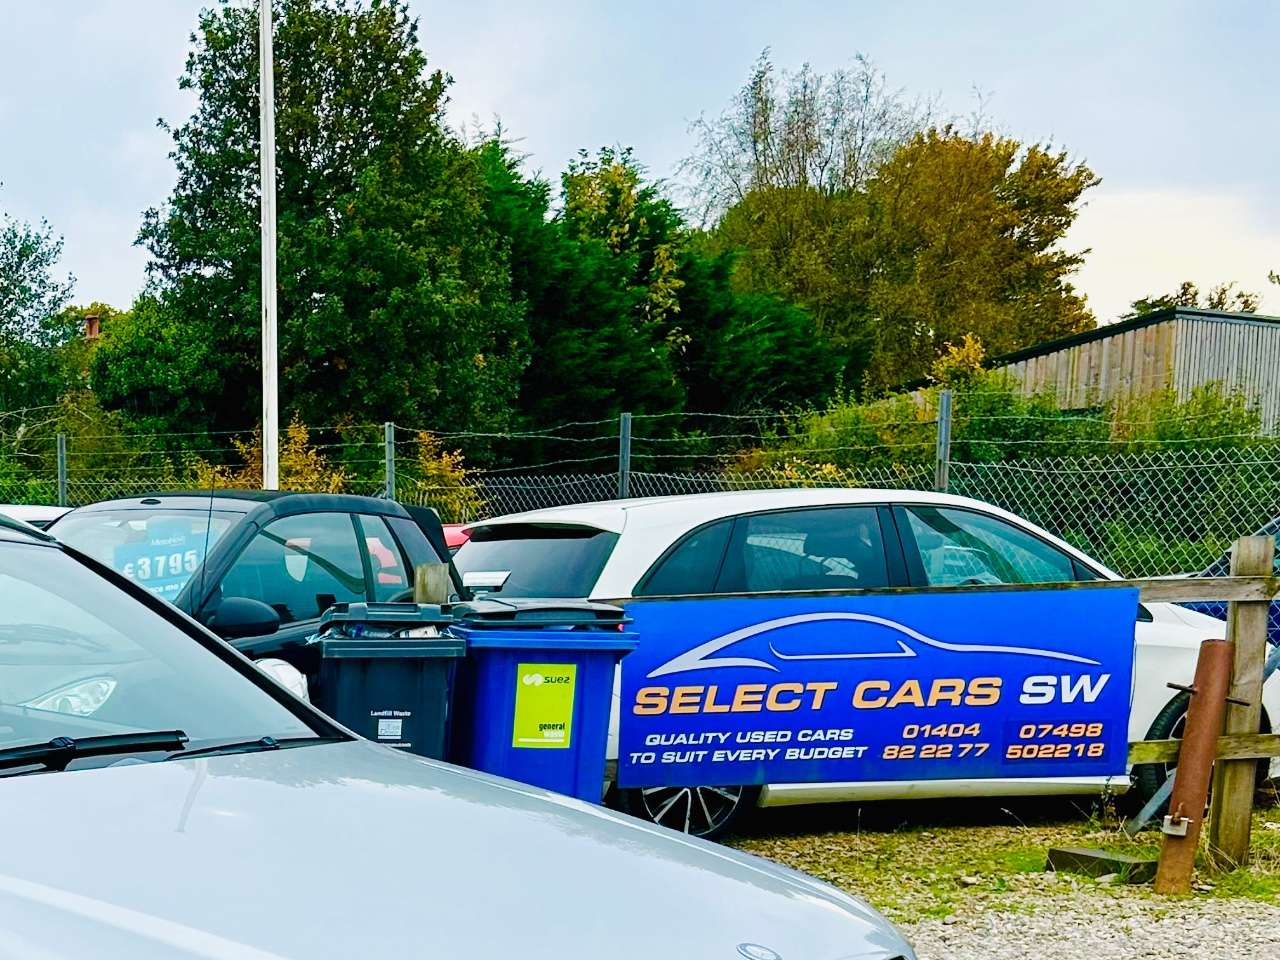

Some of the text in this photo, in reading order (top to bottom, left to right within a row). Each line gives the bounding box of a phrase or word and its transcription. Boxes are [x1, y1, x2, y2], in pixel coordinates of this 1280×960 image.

[543, 676, 570, 684] suez
[632, 673, 1112, 716] SELECT CARS SW
[538, 722, 566, 732] general
[902, 723, 981, 739] 01404
[1019, 723, 1104, 739] 07498
[644, 728, 855, 746] QUALITY USED CARS
[629, 746, 870, 765] TO SUIT EVERY BUDGET
[882, 742, 990, 760] 82 22 77
[1005, 742, 1105, 759] 502218
